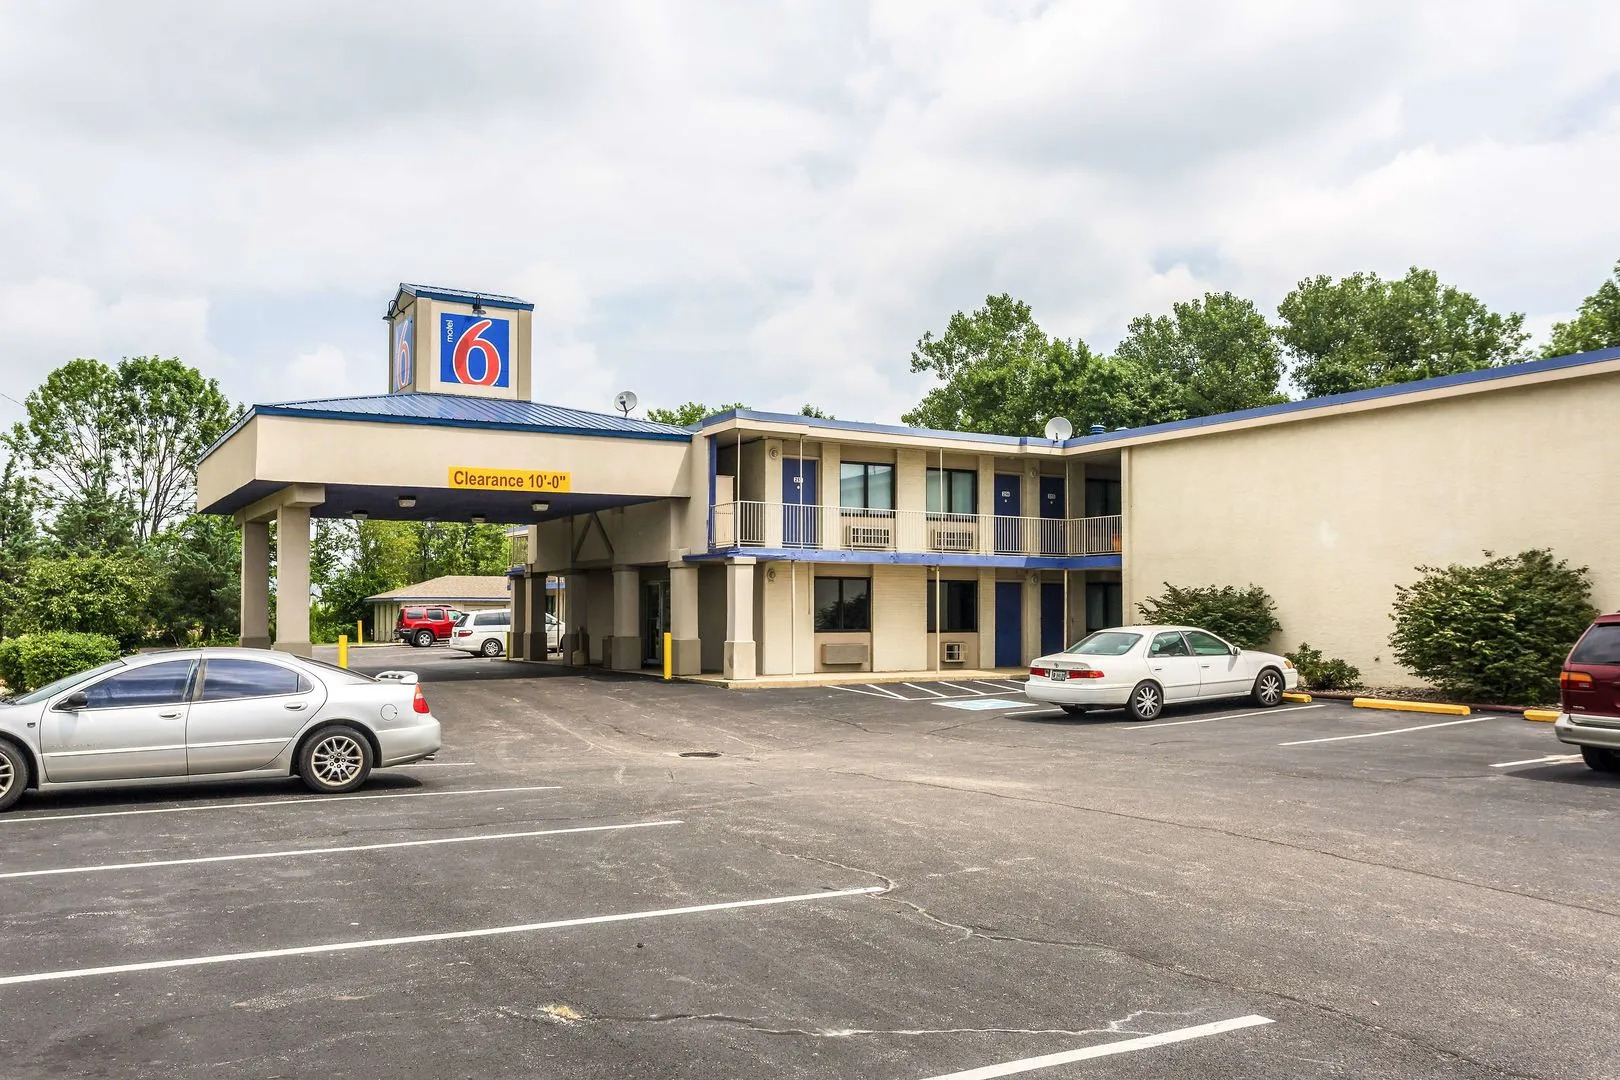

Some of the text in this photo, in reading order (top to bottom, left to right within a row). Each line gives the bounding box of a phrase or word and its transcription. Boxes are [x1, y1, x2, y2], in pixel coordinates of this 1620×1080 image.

[445, 319, 454, 343] motel
[452, 319, 502, 387] 6
[397, 320, 410, 390] 6
[453, 470, 566, 489] Clearance 10'-0"
